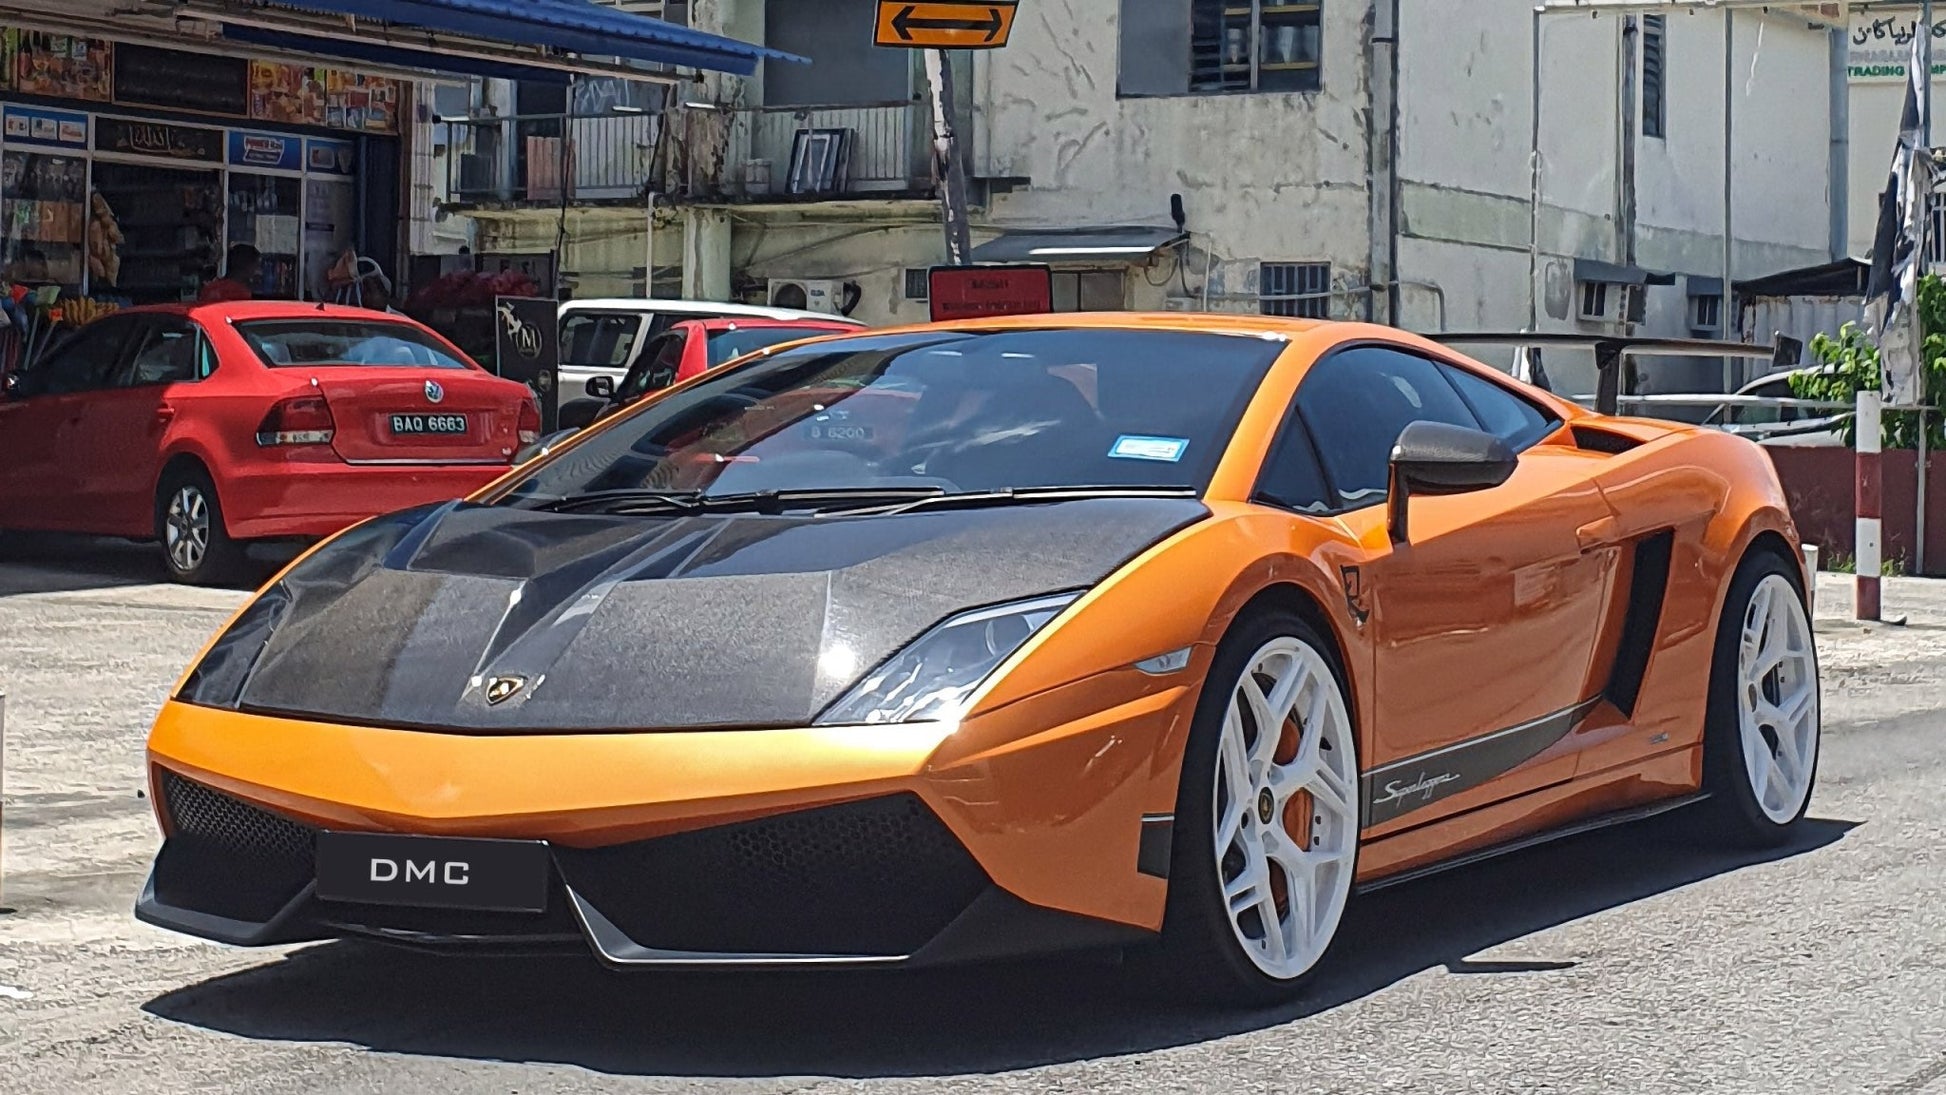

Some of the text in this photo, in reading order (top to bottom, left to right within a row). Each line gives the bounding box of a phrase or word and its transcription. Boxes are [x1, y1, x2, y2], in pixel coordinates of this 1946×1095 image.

[1847, 65, 1905, 77] TRADING
[393, 416, 465, 432] BAQ 6663
[370, 858, 469, 885] DMC
